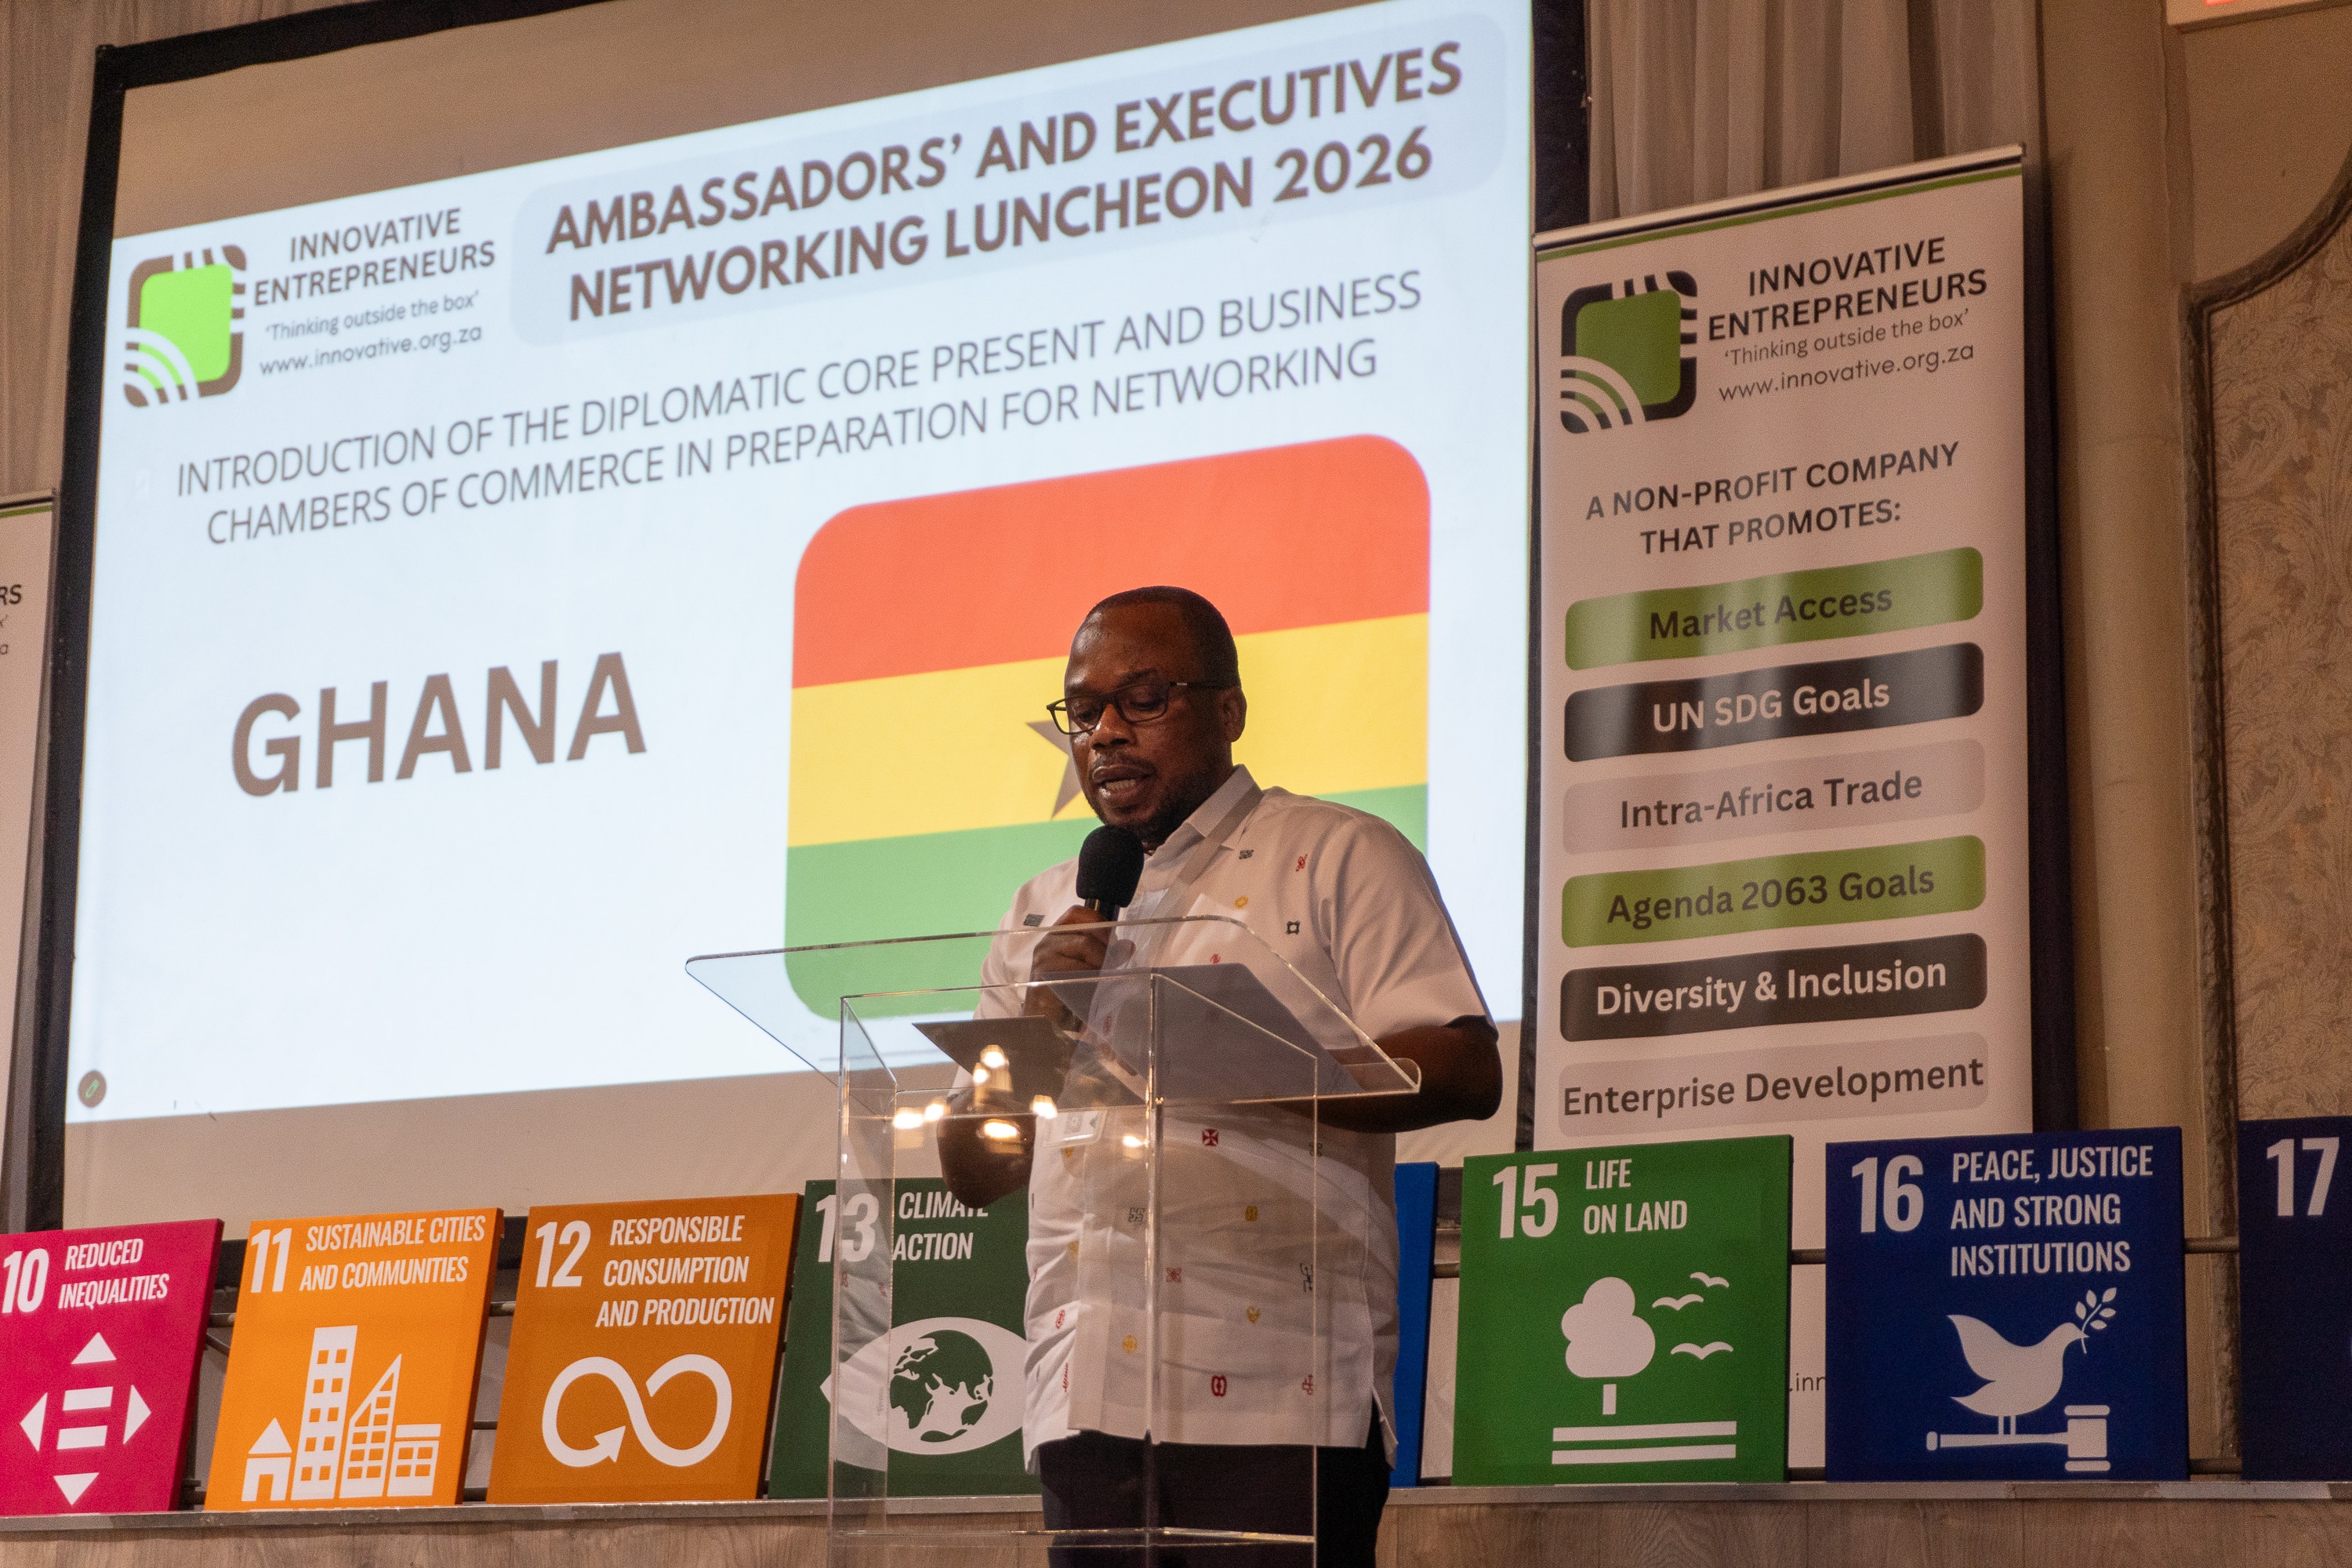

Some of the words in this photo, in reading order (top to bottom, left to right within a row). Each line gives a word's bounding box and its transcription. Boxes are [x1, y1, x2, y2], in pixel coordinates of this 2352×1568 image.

[545, 133, 963, 254] AMBASSADORS’
[976, 112, 1097, 178] AND
[1115, 42, 1462, 153] EXECUTIVES
[291, 208, 460, 263] INNOVATIVE
[570, 215, 928, 321] NETWORKING
[946, 157, 1254, 259] LUNCHEON
[1273, 126, 1432, 202] 2026
[255, 240, 495, 306] ENTREPRENEURS
[1749, 237, 1945, 296] INNOVATIVE
[266, 316, 339, 340] ‘Thinking
[343, 305, 405, 329] outside
[412, 299, 438, 318] the
[443, 289, 478, 312] box’
[1708, 268, 1987, 341] ENTREPRENEURS
[260, 326, 481, 376] www.innovative.org.za
[1725, 338, 1808, 365] ‘Thinking
[1814, 325, 1886, 351] outside
[1892, 319, 1922, 338] the
[1929, 308, 1969, 331] box’
[177, 425, 435, 496] INTRODUCTION
[447, 417, 493, 456] OF
[503, 405, 570, 447] THE
[582, 368, 806, 435] DIPLOMATIC
[818, 350, 919, 398] CORE
[933, 321, 1105, 382] PRESENT
[1115, 307, 1203, 354] AND
[1220, 270, 1421, 337] BUSINESS
[1719, 344, 1973, 401] www.innovative.org.za
[208, 487, 390, 544] CHAMBERS
[403, 478, 448, 516] OF
[458, 446, 663, 509] COMMERCE
[677, 438, 712, 477] IN
[726, 397, 987, 470] PREPARATION
[1003, 383, 1079, 430] FOR
[1094, 339, 1377, 417] NETWORKING
[1585, 495, 1604, 521] A
[1612, 466, 1798, 516] NON-PROFIT
[1806, 441, 1959, 488] COMPANY
[1640, 524, 1719, 554] THAT
[1728, 498, 1901, 546] PROMOTES:
[1650, 601, 1766, 640] Market
[1773, 589, 1893, 624] Access
[232, 651, 647, 797] GHANA
[1653, 700, 1704, 733] UN
[1715, 689, 1782, 726] SDG
[1792, 678, 1889, 717] Goals
[1621, 782, 1813, 829] Intra-Africa
[1824, 770, 1922, 808] Trade
[1606, 887, 1733, 930] Agenda
[1741, 874, 1828, 910] 2063
[1838, 864, 1934, 903] Goals
[1597, 975, 1746, 1016] Diversity
[1755, 971, 1778, 1003] &
[1788, 959, 1947, 1000] Inclusion
[1563, 1073, 1735, 1120] Enterprise
[1745, 1058, 1984, 1103] Development
[1585, 1159, 1632, 1189] LIFE
[1952, 1149, 2041, 1184] PEACE,
[2047, 1145, 2154, 1179] JUSTICE
[2266, 1137, 2340, 1217] 17
[1493, 1163, 1559, 1239] 15
[1584, 1203, 1617, 1234] ON
[1625, 1200, 1687, 1232] LAND
[1851, 1154, 1924, 1233] 16
[1951, 1198, 2005, 1230] AND
[2013, 1193, 2121, 1226] STRONG
[65, 1238, 143, 1271] REDUCED
[306, 1218, 426, 1252] SUSTAINABLE
[430, 1214, 486, 1243] CITIES
[535, 1220, 591, 1288] 12
[610, 1214, 745, 1246] RESPONSIBLE
[815, 1193, 879, 1263] 13
[893, 1232, 974, 1261] ACTION
[2, 1248, 49, 1313] 10
[250, 1227, 292, 1293] 11
[299, 1264, 338, 1291] AND
[340, 1255, 469, 1290] COMMUNITIES
[604, 1256, 750, 1287] CONSUMPTION
[1951, 1240, 2131, 1276] INSTITUTIONS
[58, 1273, 170, 1310] INEQUALITIES
[595, 1301, 640, 1328] AND
[643, 1297, 775, 1326] PRODUCTION
